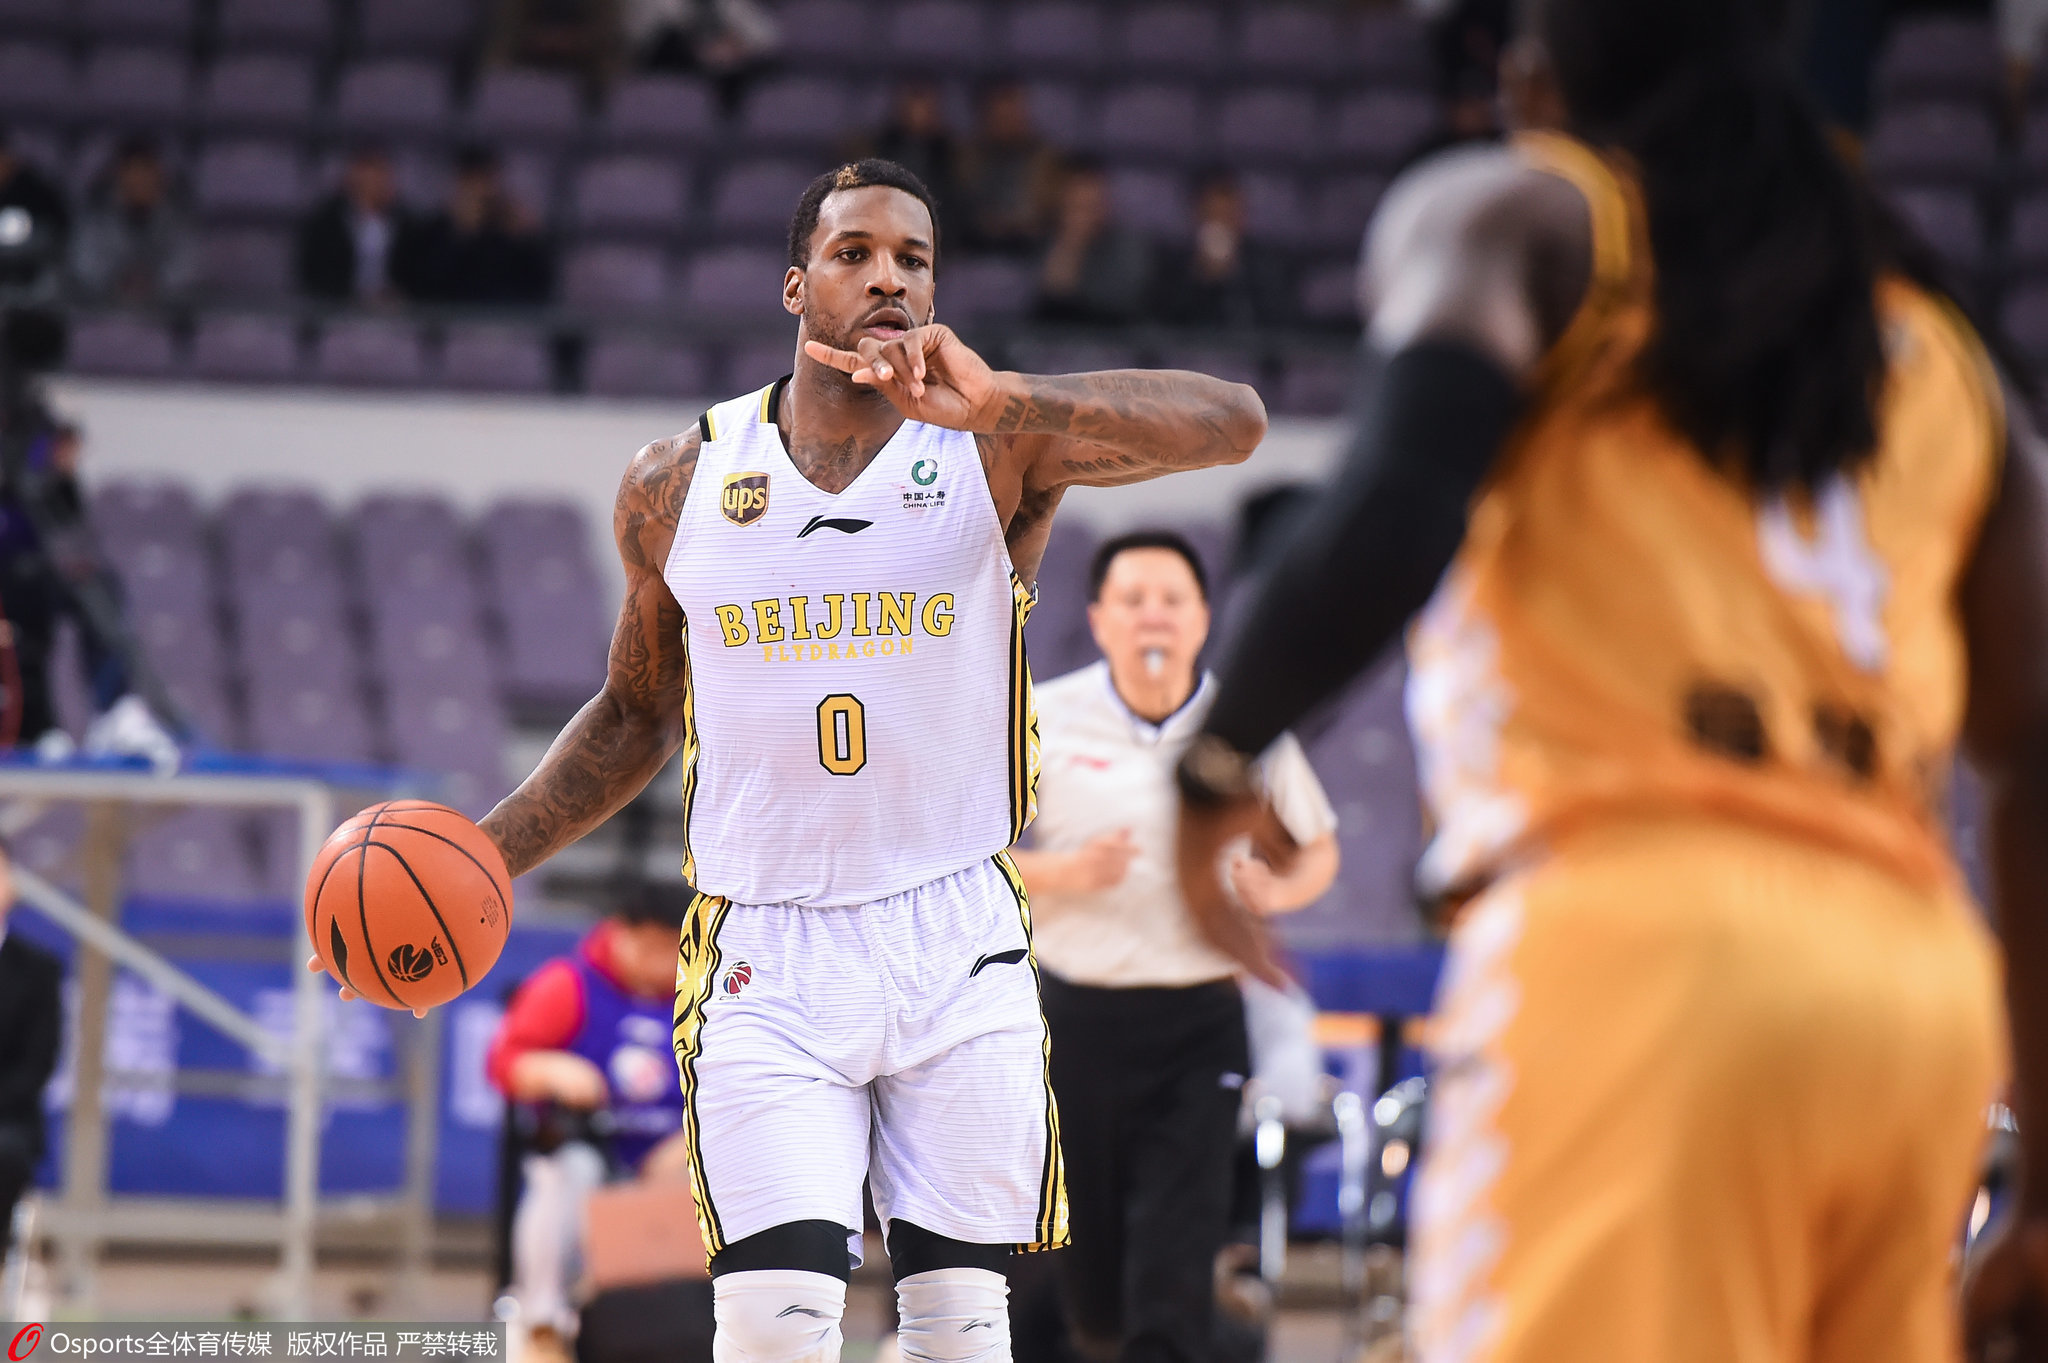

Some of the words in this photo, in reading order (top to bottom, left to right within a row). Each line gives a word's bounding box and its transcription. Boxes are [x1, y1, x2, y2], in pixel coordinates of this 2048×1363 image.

[724, 487, 766, 518] ups
[903, 491, 945, 501] 中国人寿
[715, 592, 955, 647] BEIJING
[816, 693, 867, 776] 0
[431, 935, 448, 966] CBA
